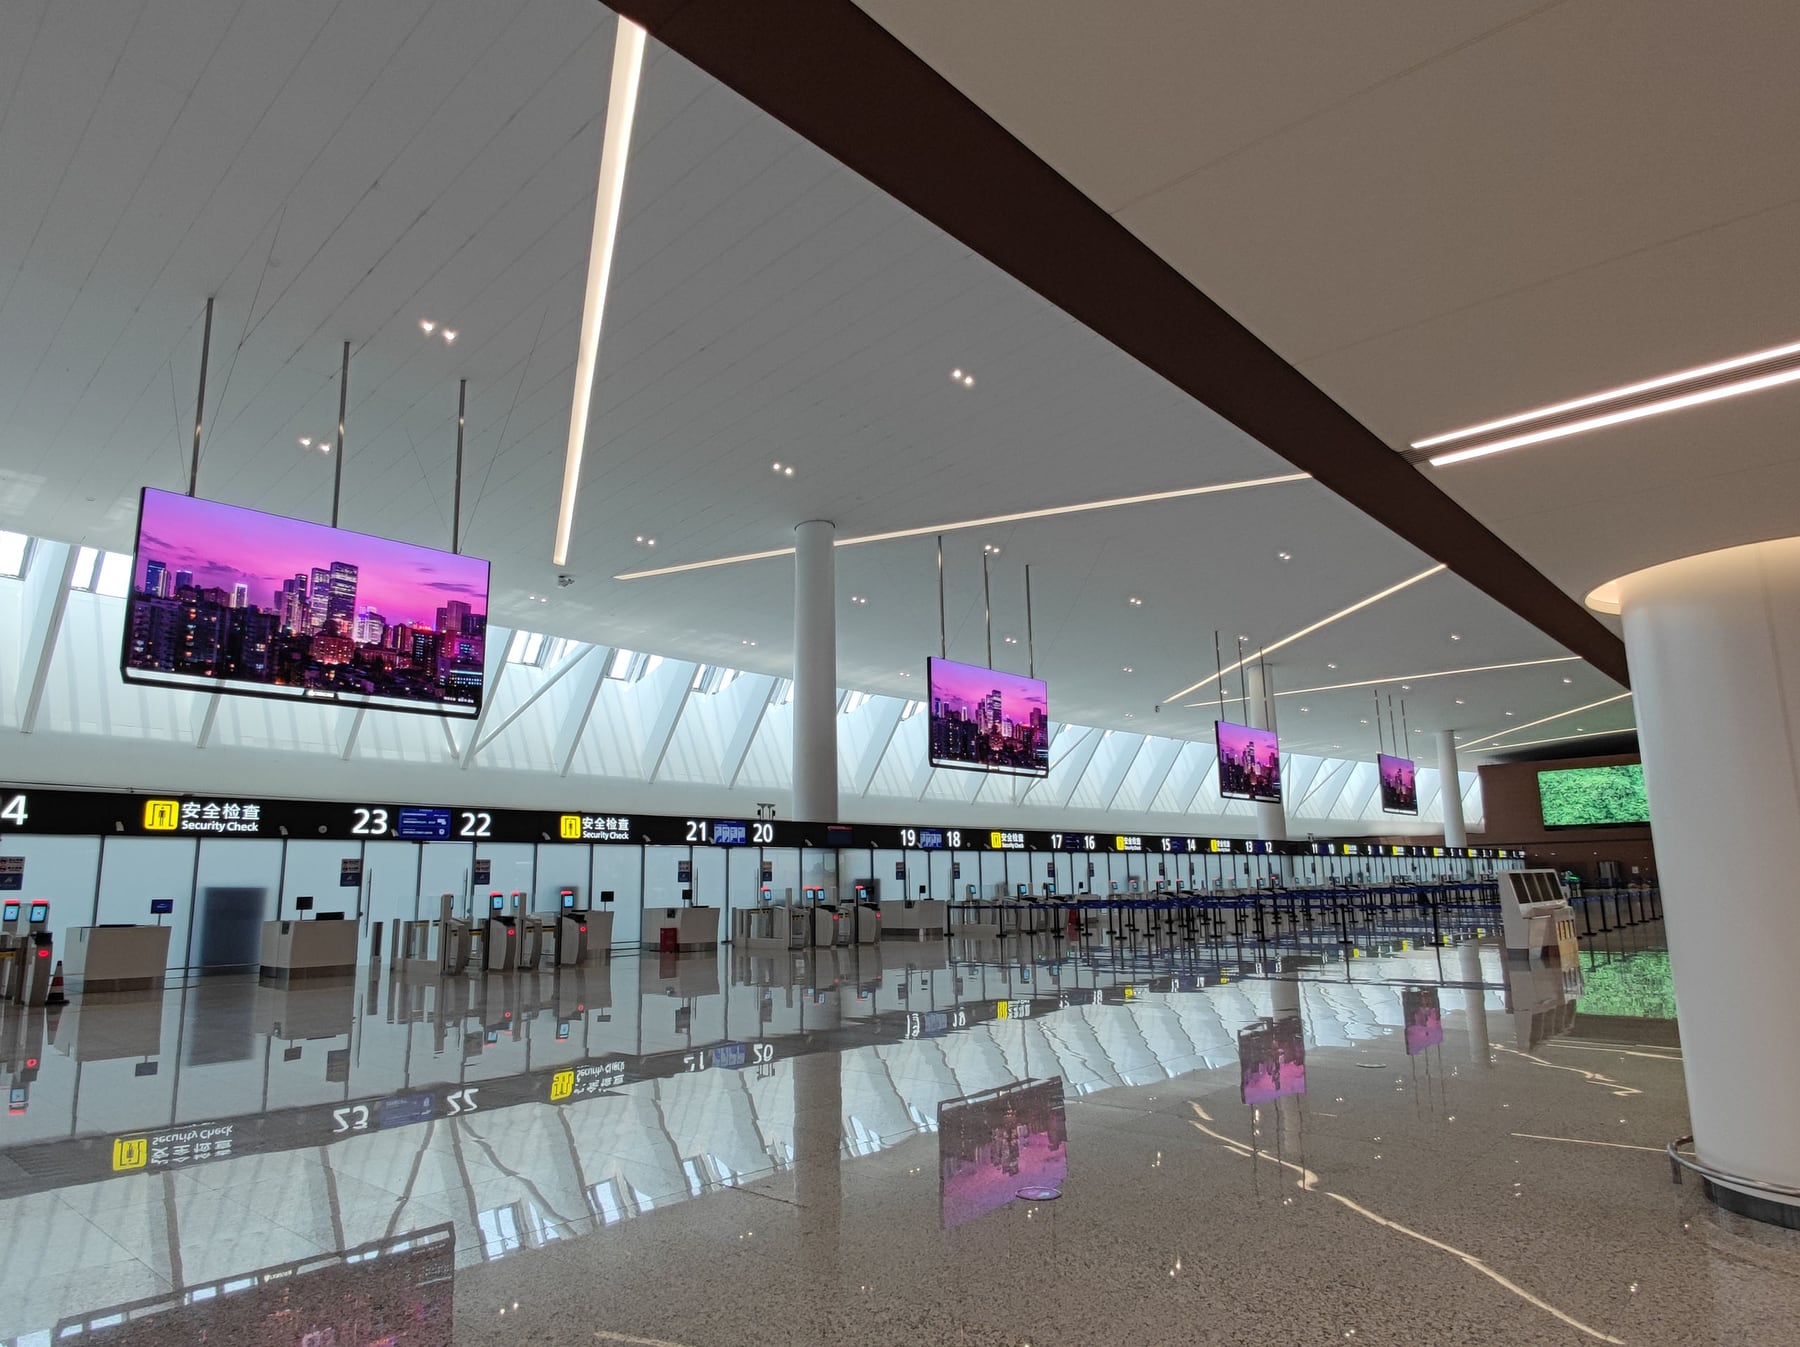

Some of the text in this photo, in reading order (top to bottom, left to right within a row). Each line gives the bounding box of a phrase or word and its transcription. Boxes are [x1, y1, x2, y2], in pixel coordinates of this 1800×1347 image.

[0, 795, 28, 825] 4
[181, 801, 261, 820] 安全检查
[181, 820, 259, 832] Security Check
[351, 808, 389, 835] 23
[460, 812, 492, 837] 22
[582, 816, 630, 831] 安全检查
[582, 830, 630, 841] Security Check
[686, 820, 707, 842] 21
[752, 822, 774, 844] 20
[900, 829, 916, 847] 19
[946, 831, 961, 848] 18
[1051, 834, 1063, 849] 17
[1084, 835, 1096, 850] 16
[1161, 838, 1171, 852] 15
[1187, 839, 1197, 852] 14
[1245, 841, 1253, 853] 13
[1265, 841, 1273, 853] 12
